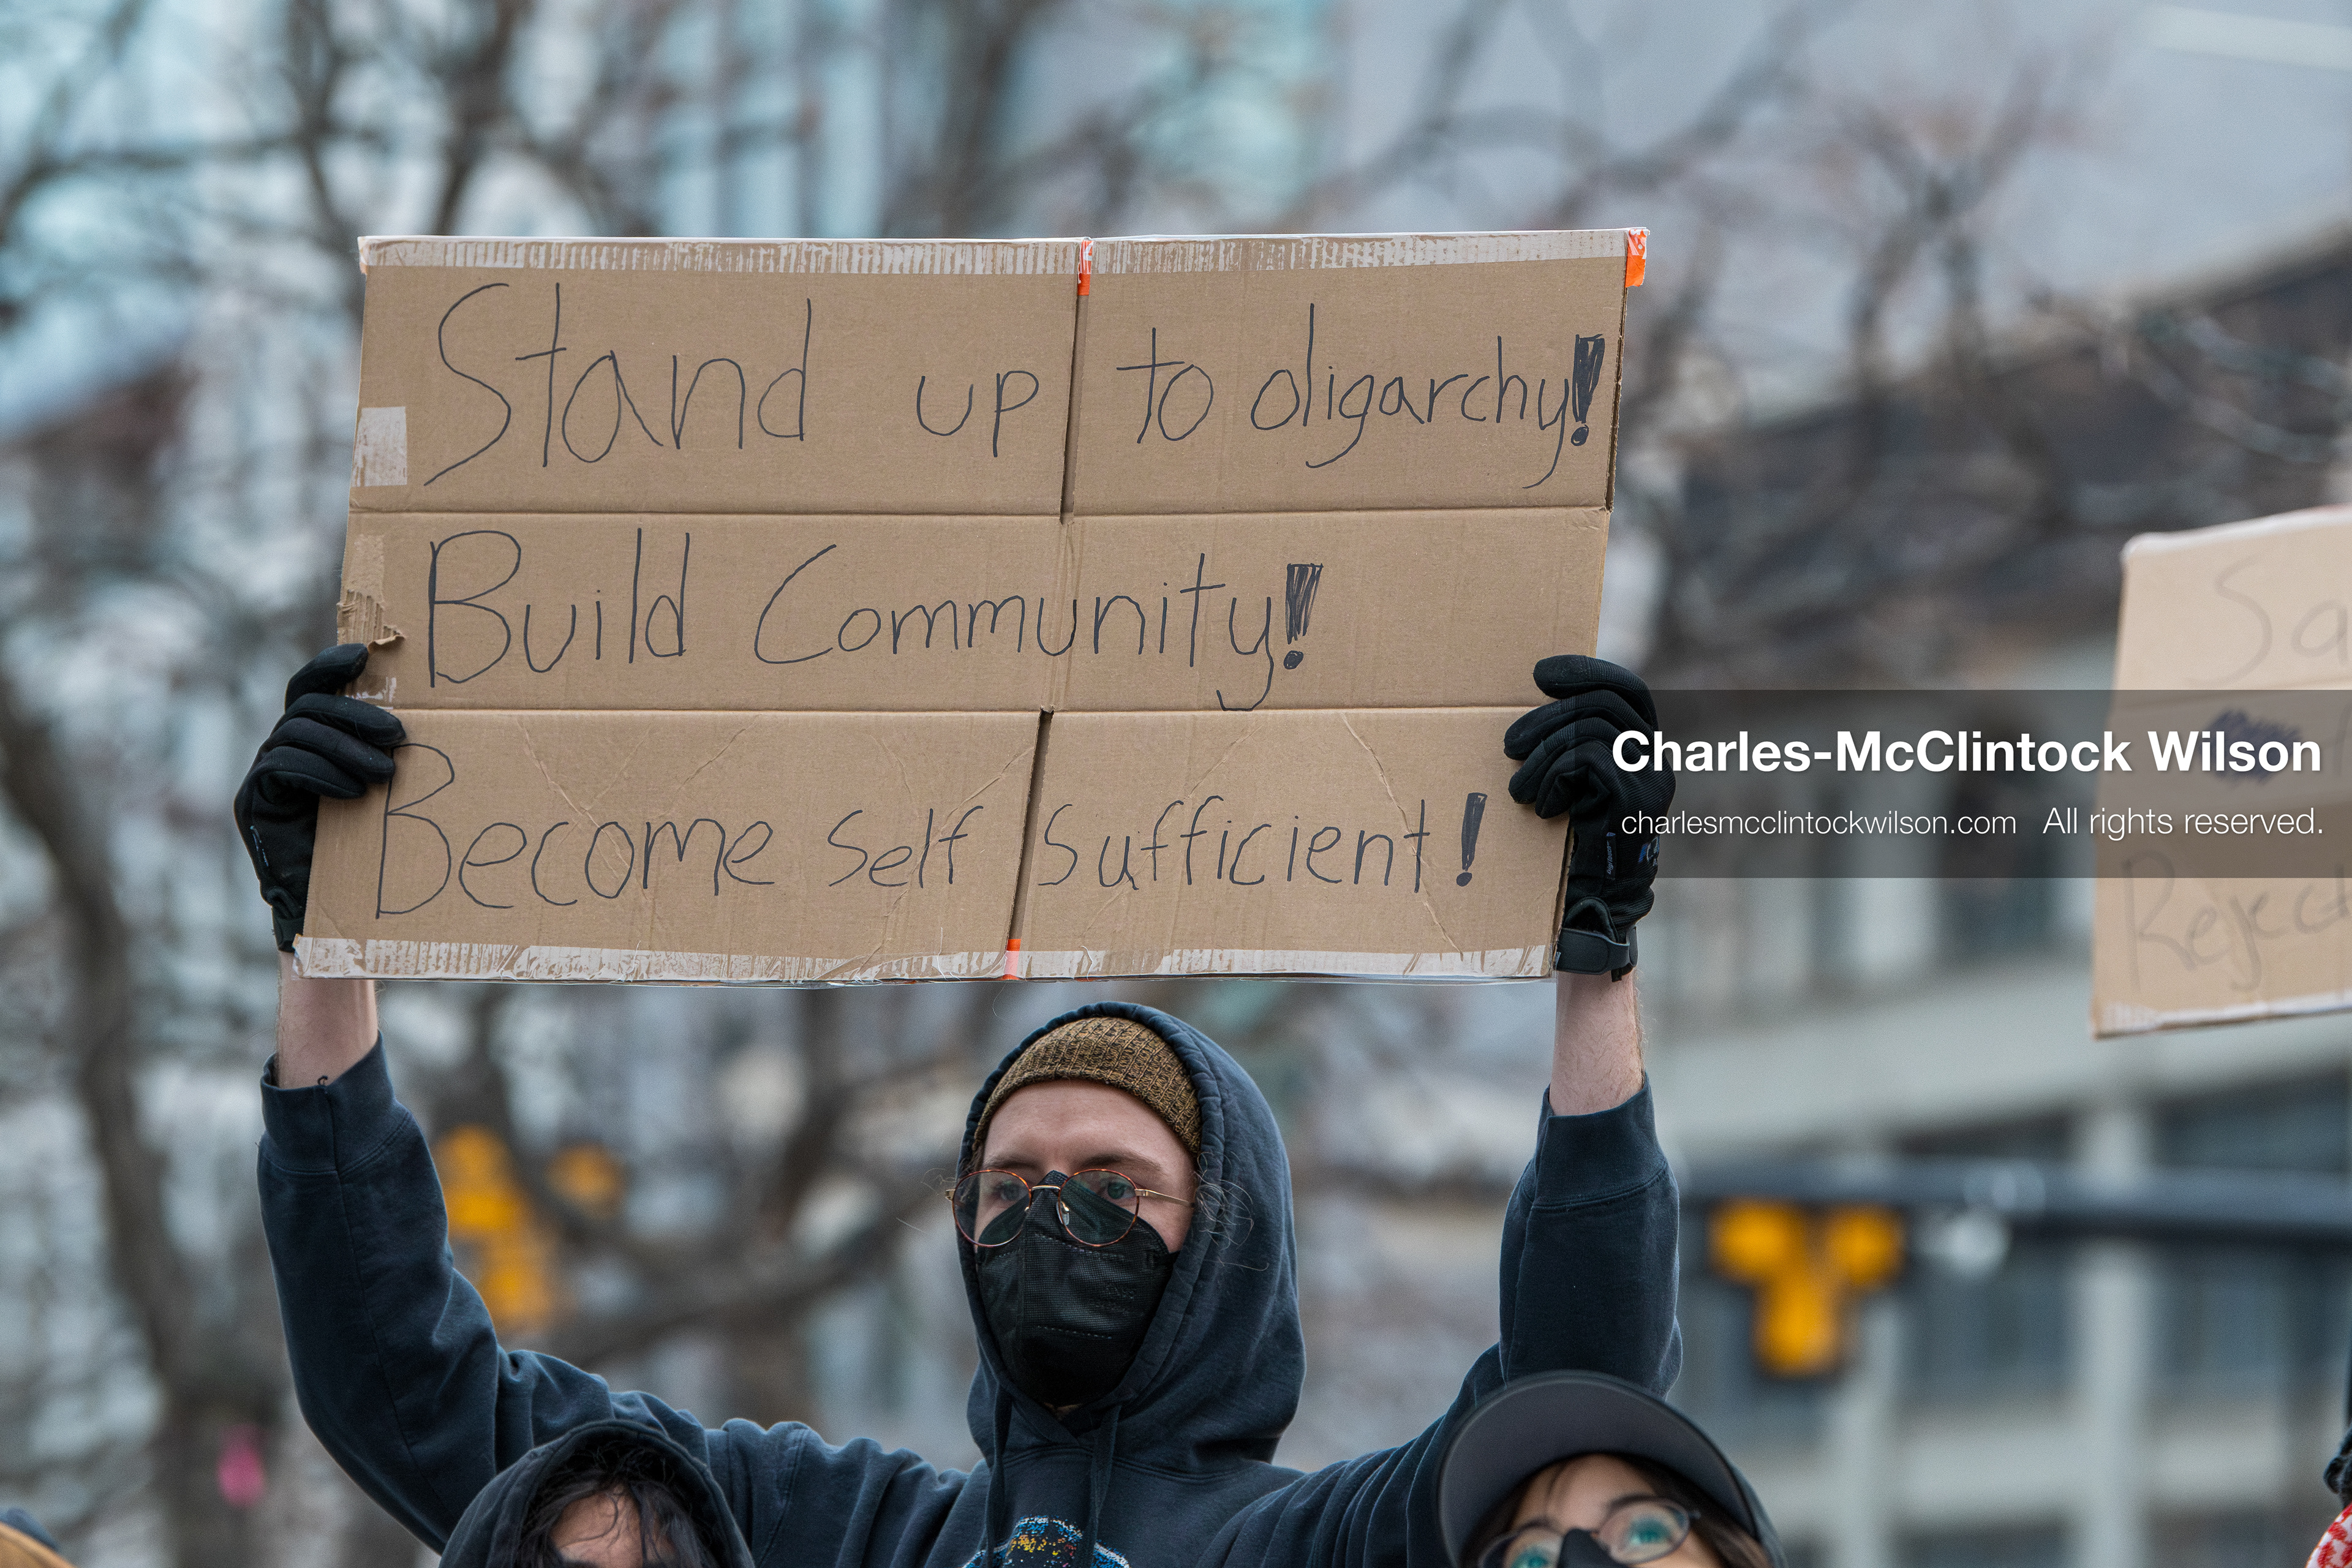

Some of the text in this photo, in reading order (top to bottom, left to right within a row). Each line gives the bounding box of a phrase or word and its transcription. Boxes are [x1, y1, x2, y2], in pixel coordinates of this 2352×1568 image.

[423, 281, 1605, 489] Stand up to oligarchy!
[428, 527, 1324, 712] Build Community!
[374, 742, 775, 919] Become
